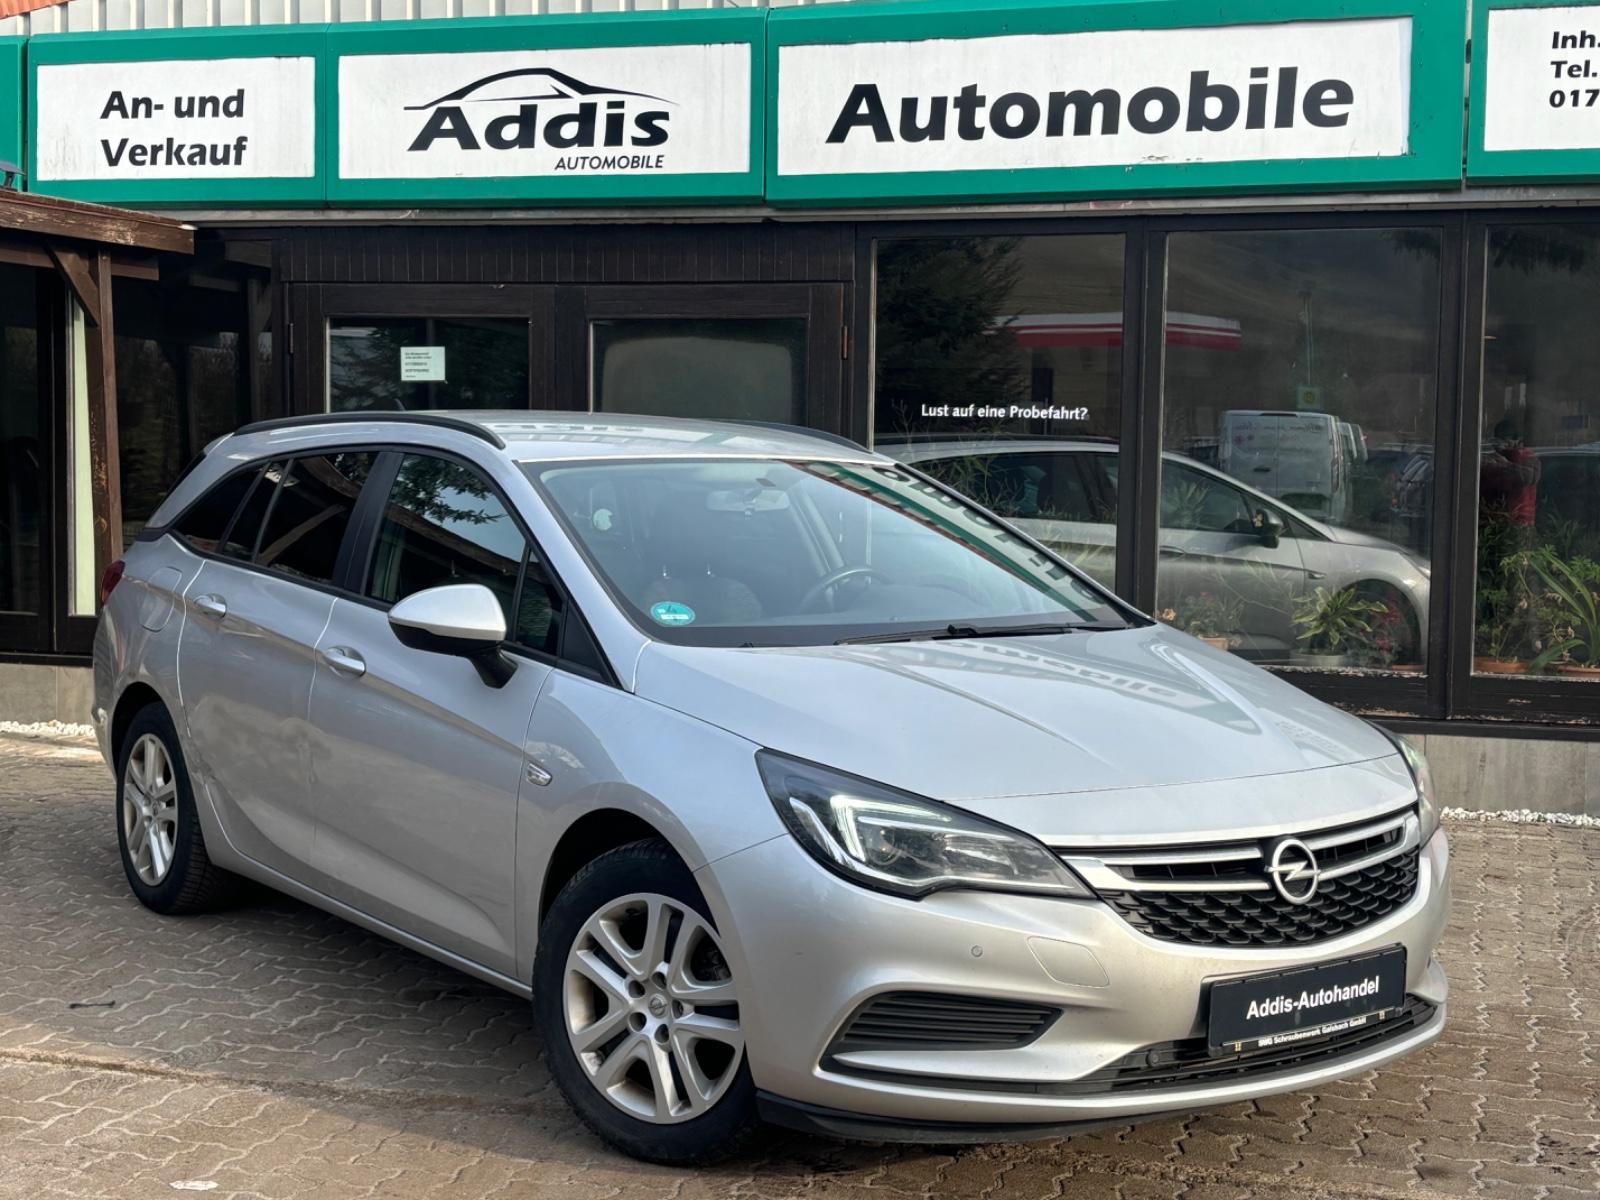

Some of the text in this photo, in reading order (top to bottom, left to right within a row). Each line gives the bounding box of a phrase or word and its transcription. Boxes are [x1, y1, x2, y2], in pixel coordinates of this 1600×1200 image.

[1552, 30, 1600, 49] Inh.
[1550, 59, 1598, 79] Tel.
[101, 89, 244, 119] An- und
[826, 67, 1354, 144] Automobile
[1549, 89, 1600, 108] 017
[406, 100, 670, 152] Addis
[101, 137, 247, 167] Verkauf
[555, 154, 665, 170] AUTOMOBILE
[921, 404, 1089, 420] Lust auf eine Probefahrt?
[1246, 976, 1380, 1020] Addis-Autohandel
